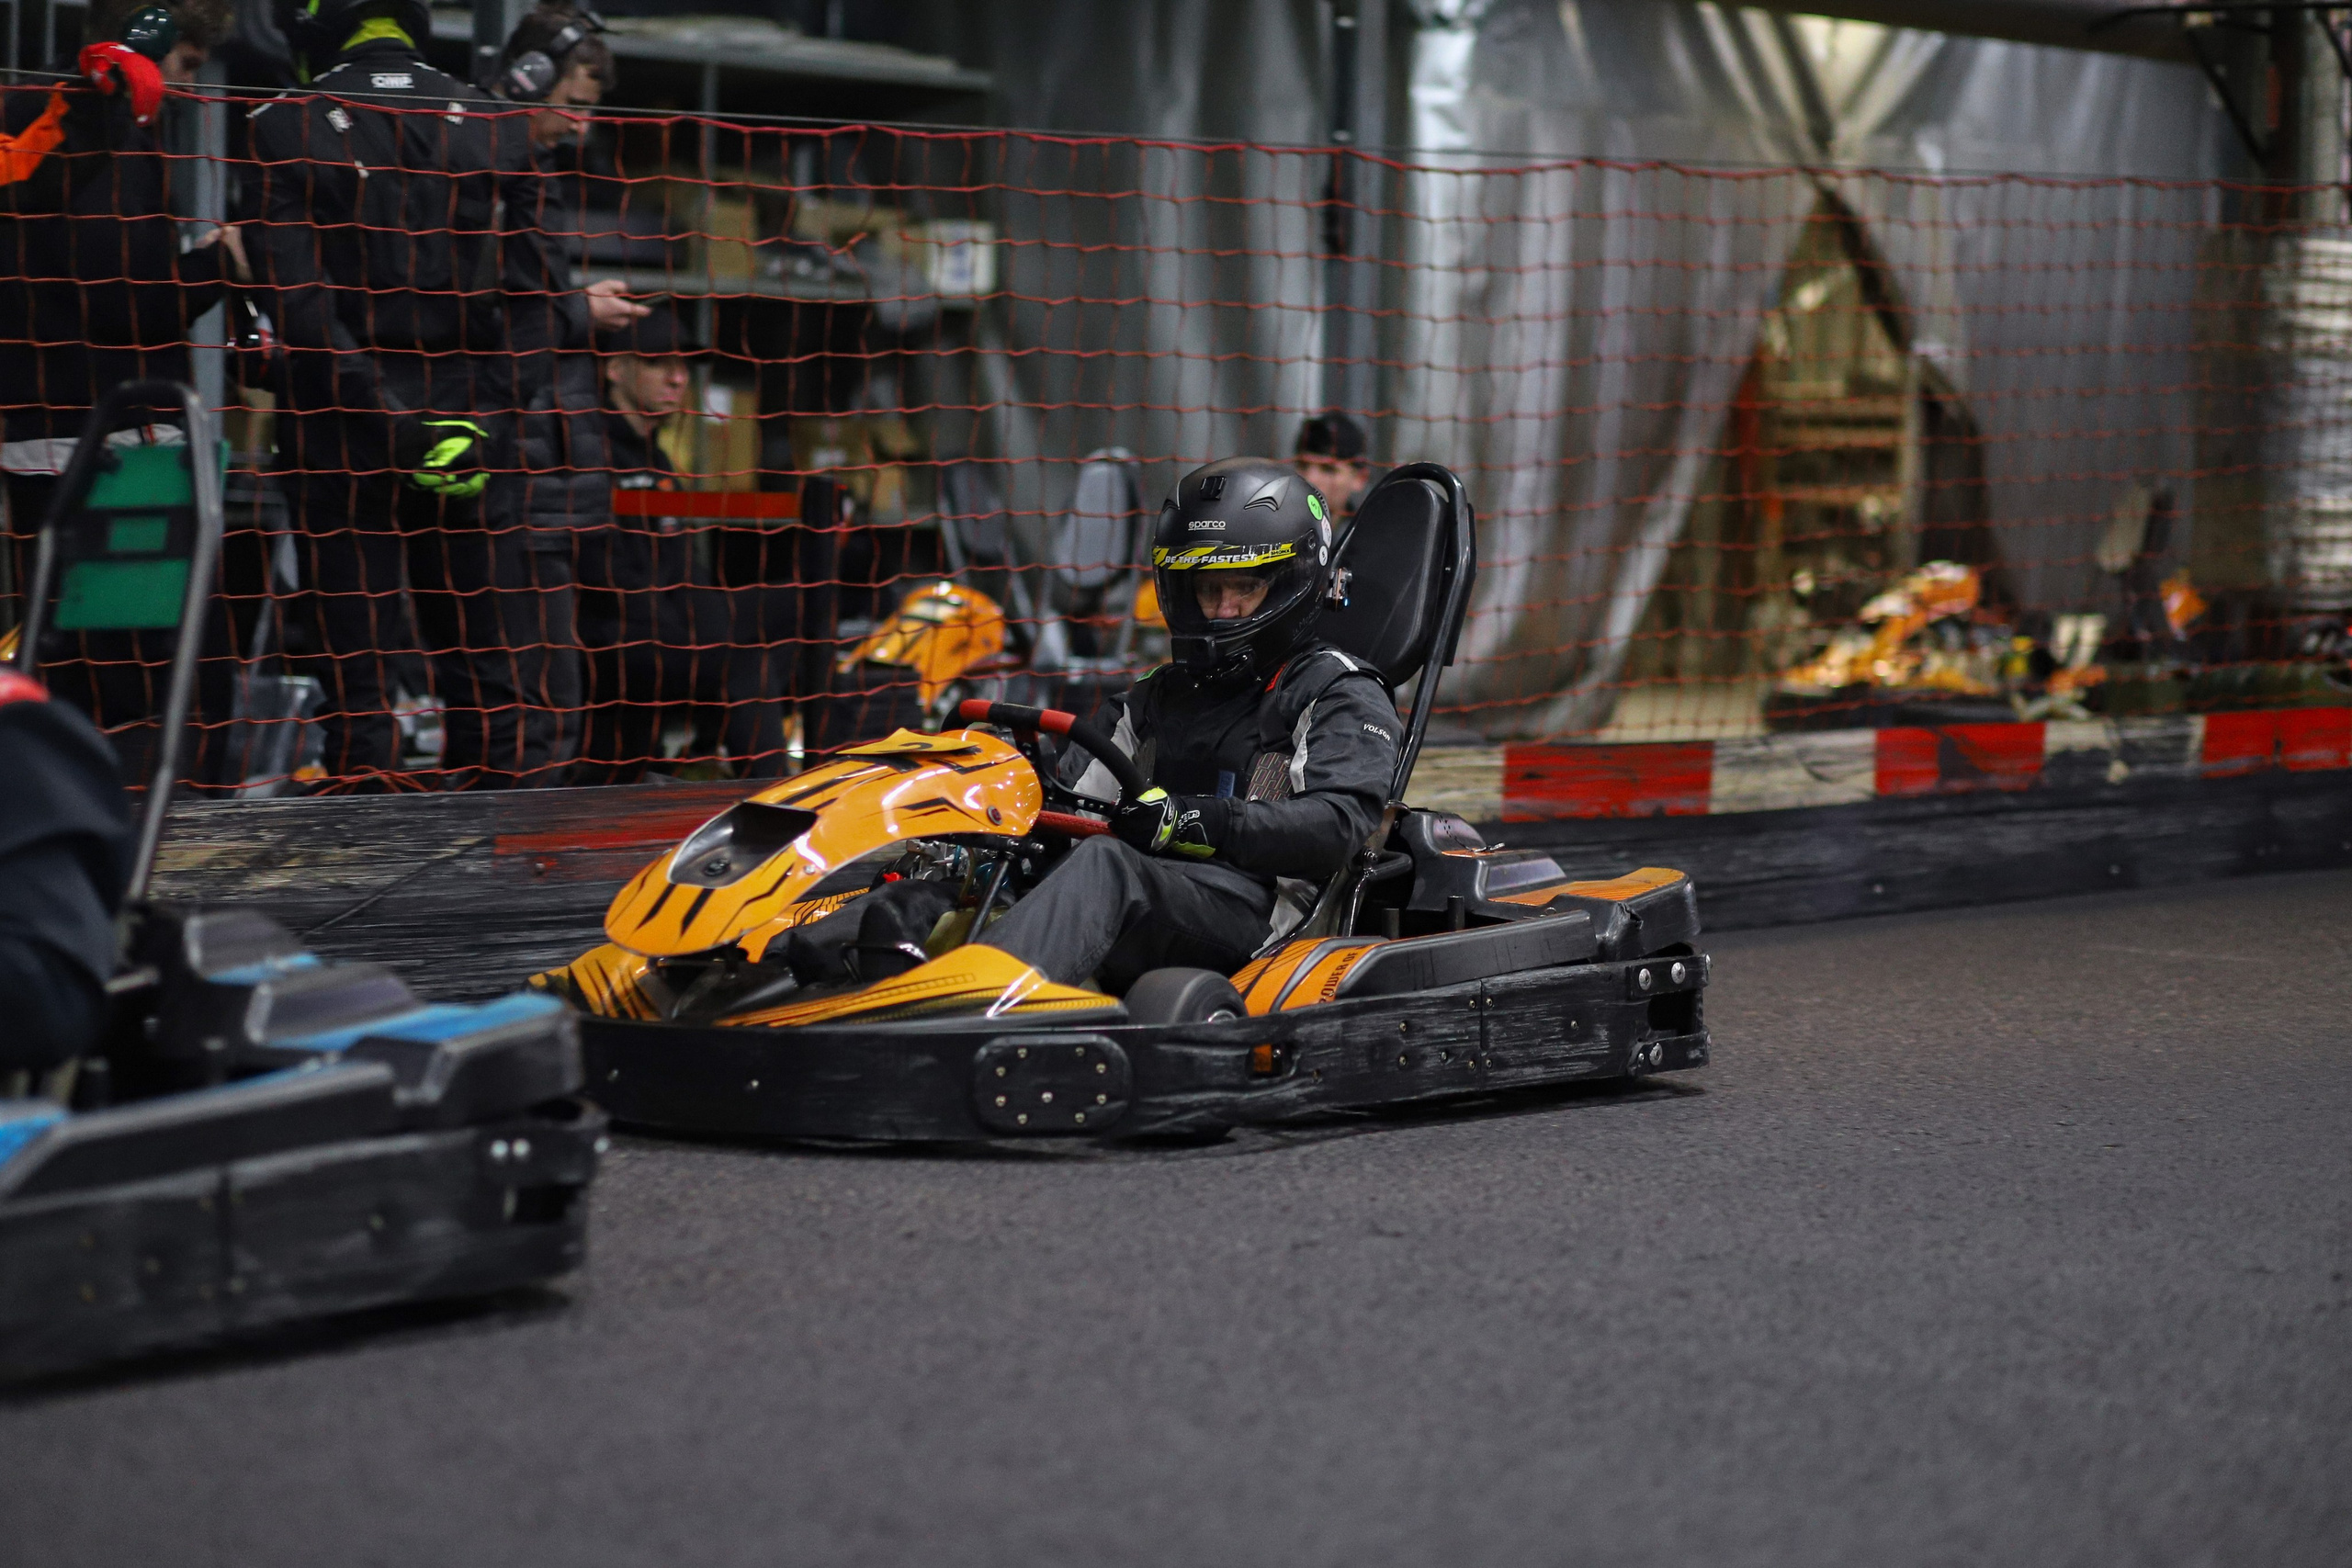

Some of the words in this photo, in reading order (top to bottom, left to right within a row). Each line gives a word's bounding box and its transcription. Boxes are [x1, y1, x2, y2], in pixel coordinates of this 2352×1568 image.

[1188, 520, 1227, 531] sparco
[1165, 556, 1176, 564] BE
[1179, 556, 1199, 564] THE
[1201, 554, 1258, 563] FASTEST
[1363, 723, 1392, 741] VOLSON
[1342, 952, 1359, 963] OF
